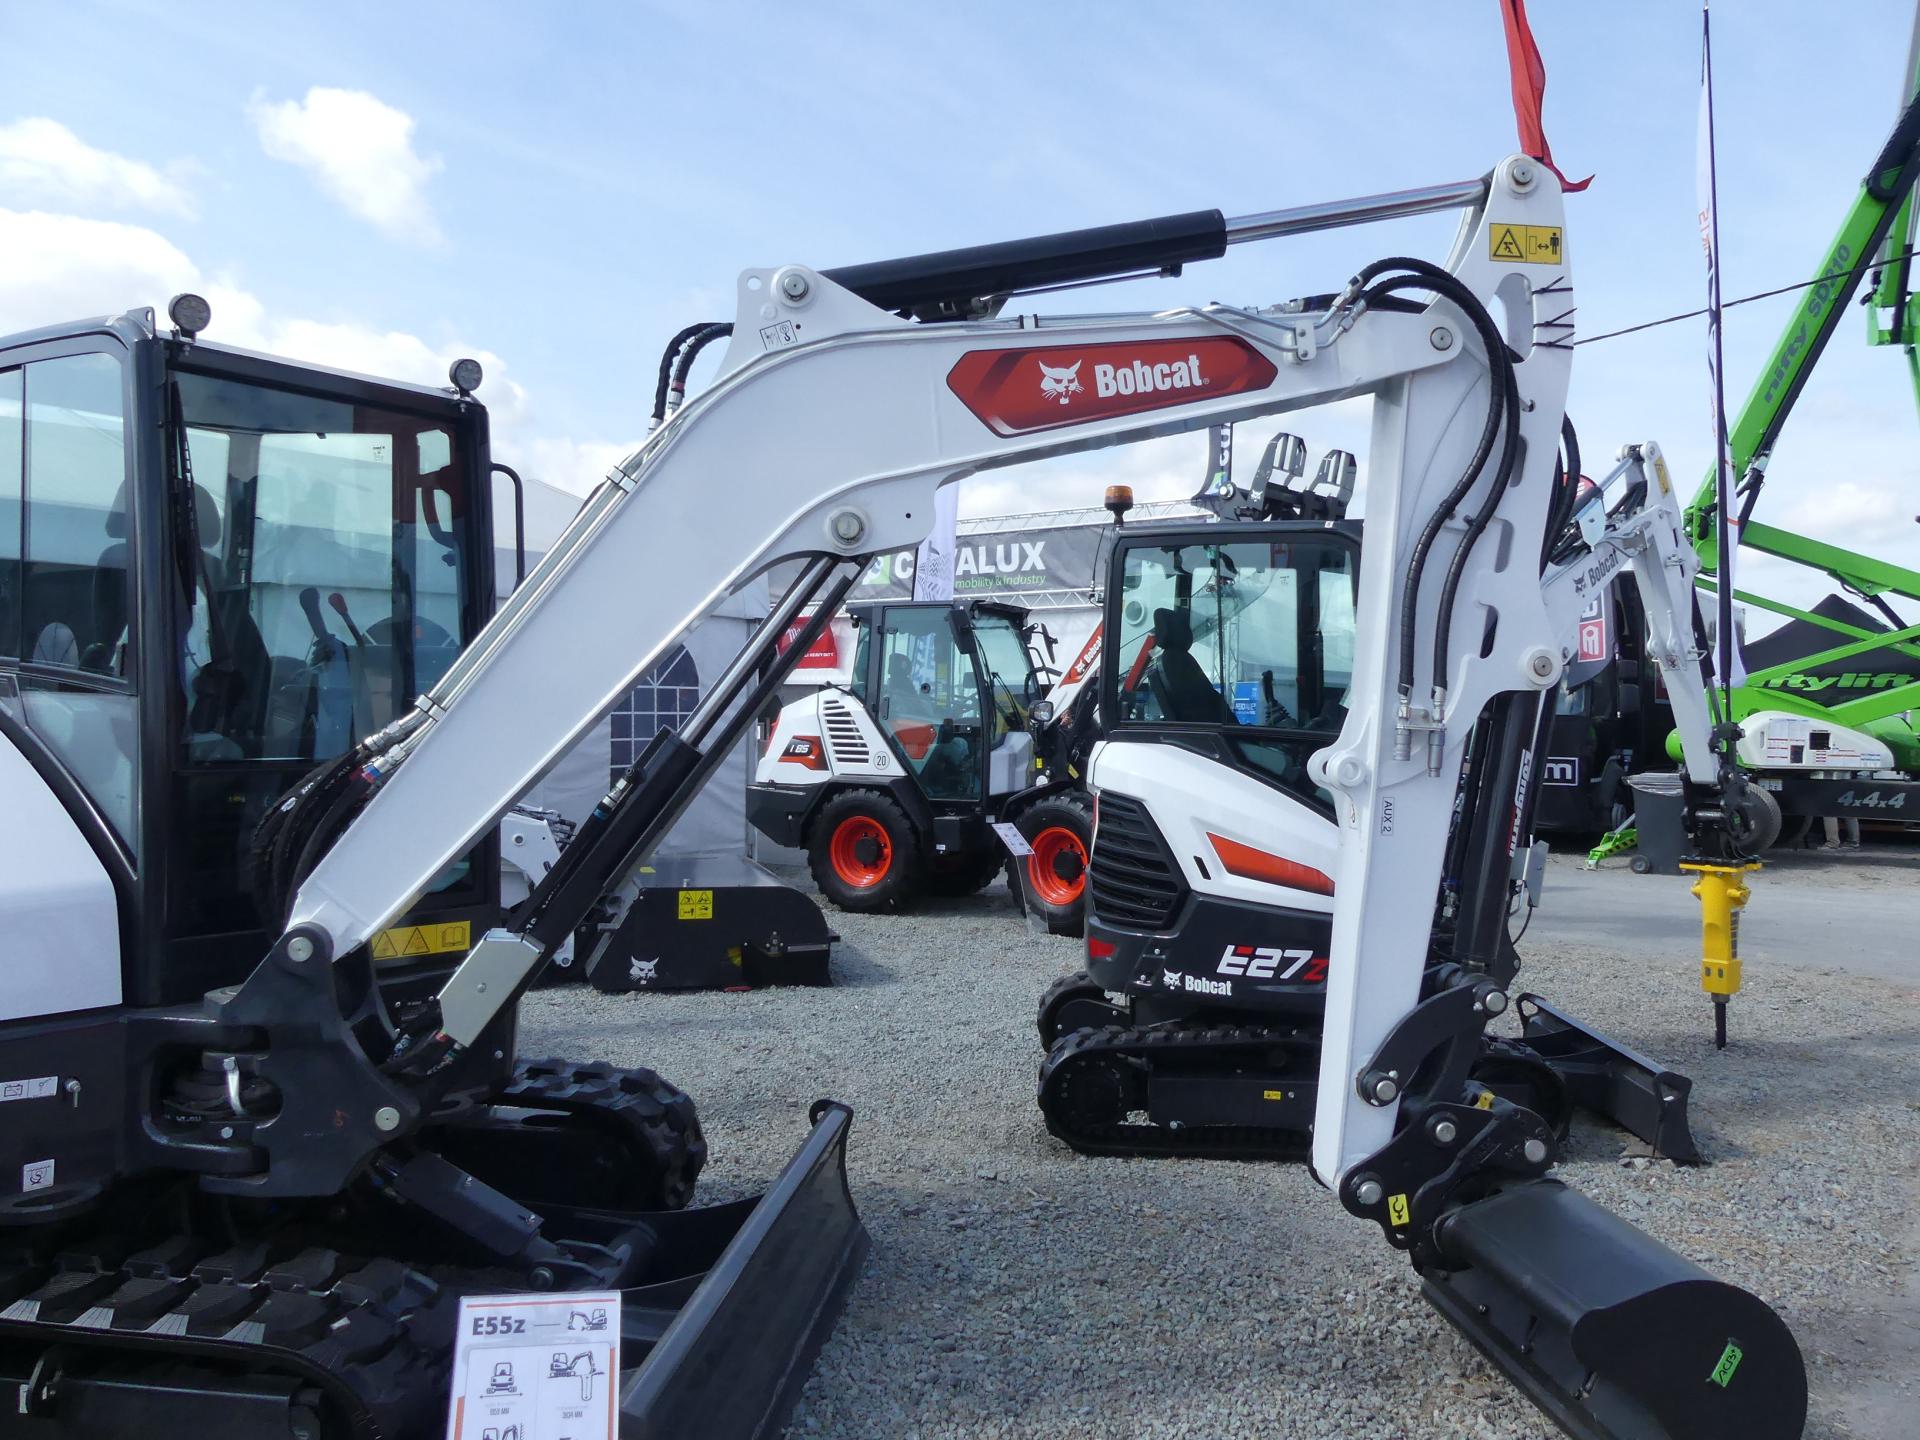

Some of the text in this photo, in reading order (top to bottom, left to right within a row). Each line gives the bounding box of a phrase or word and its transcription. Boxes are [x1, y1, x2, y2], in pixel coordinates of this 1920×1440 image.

[1765, 244, 1850, 403] nifty SD210
[1094, 354, 1202, 398] Bobcat
[1588, 548, 1619, 587] Bobcat
[955, 575, 1046, 589] mobility & industry
[877, 755, 887, 766] 20
[1837, 790, 1906, 809] 4x4x4
[1383, 800, 1392, 823] AUX
[1184, 975, 1232, 996] Bobcat
[472, 1315, 526, 1336] E55z
